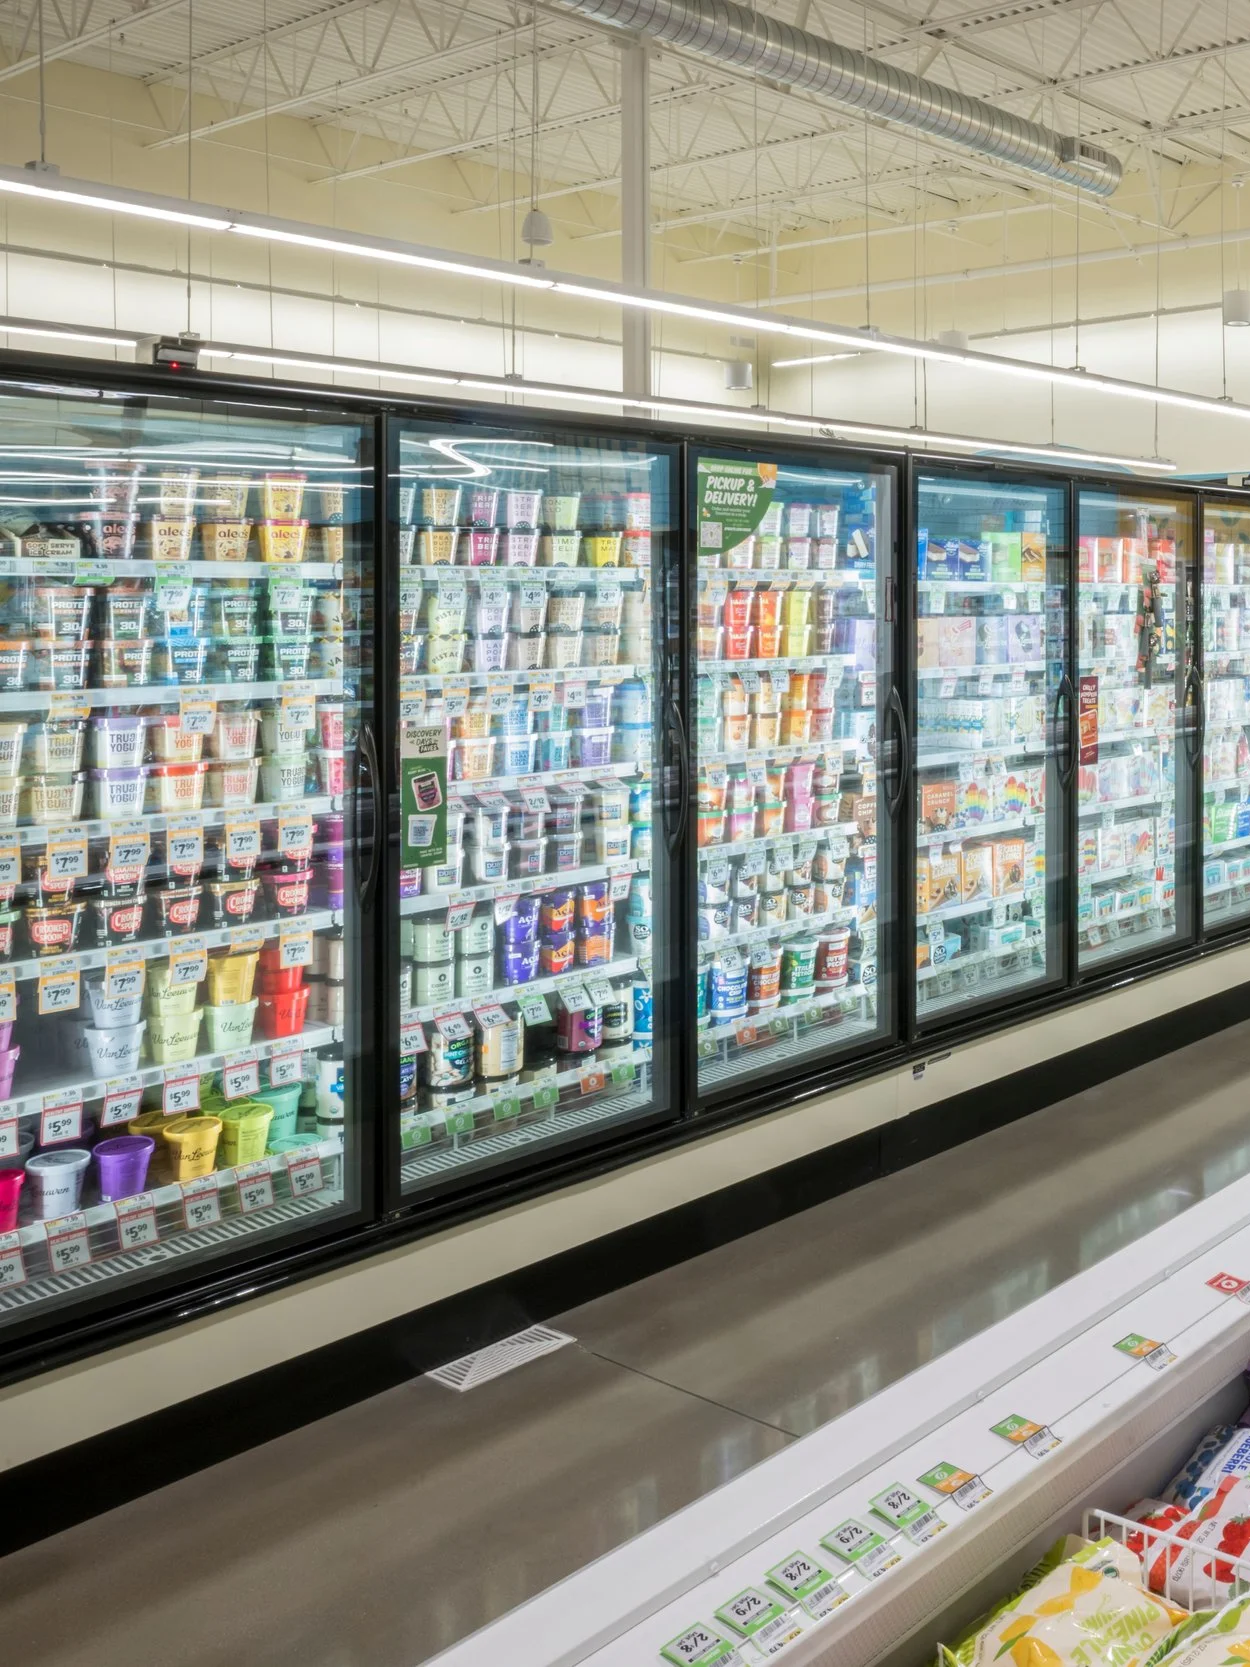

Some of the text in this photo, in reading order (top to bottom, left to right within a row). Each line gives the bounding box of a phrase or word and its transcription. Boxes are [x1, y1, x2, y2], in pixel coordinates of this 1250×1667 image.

[706, 476, 755, 492] PICKUP &
[704, 491, 758, 507] DELIVERY!
[406, 729, 442, 738] DISCOVERY
